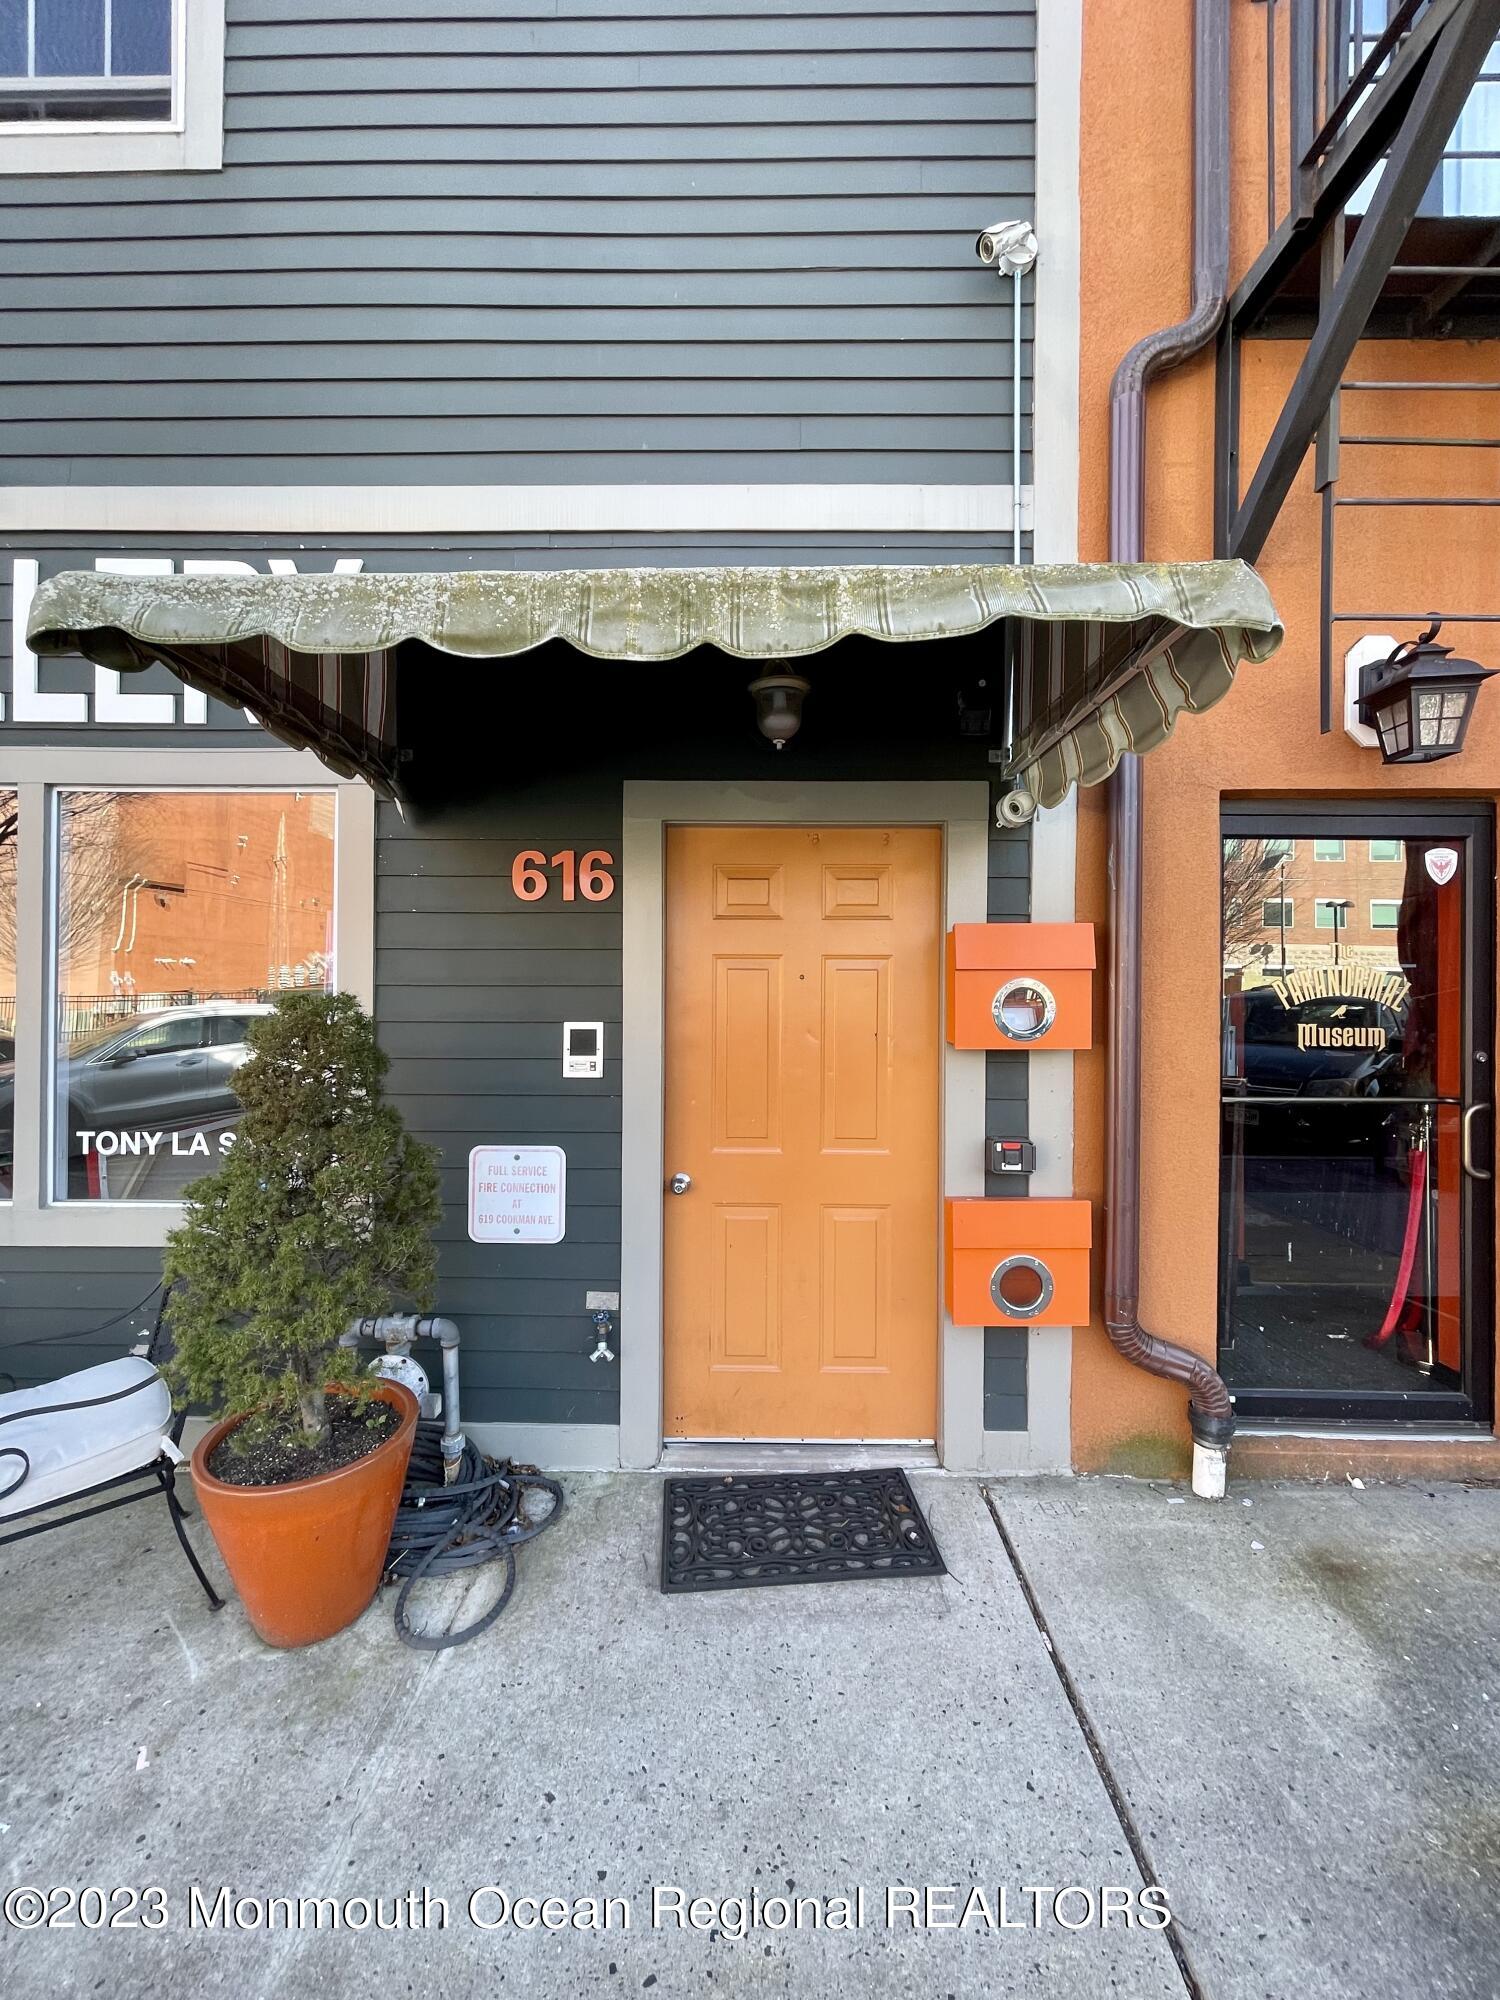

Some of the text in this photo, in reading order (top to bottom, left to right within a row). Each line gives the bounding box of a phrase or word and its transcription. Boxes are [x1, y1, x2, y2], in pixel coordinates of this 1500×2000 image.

[511, 850, 615, 902] 616
[1329, 942, 1353, 959] The
[1271, 964, 1412, 1012] PARANORMAL
[1297, 1023, 1386, 1052] Museum
[76, 1131, 162, 1156] TONY
[171, 1132, 210, 1156] LA
[488, 1165, 548, 1177] FULL SERVICE
[478, 1182, 556, 1194] FIRE CONNECTION
[512, 1199, 523, 1209] AT
[478, 1214, 494, 1224] 619
[496, 1215, 535, 1225] COOKMAN
